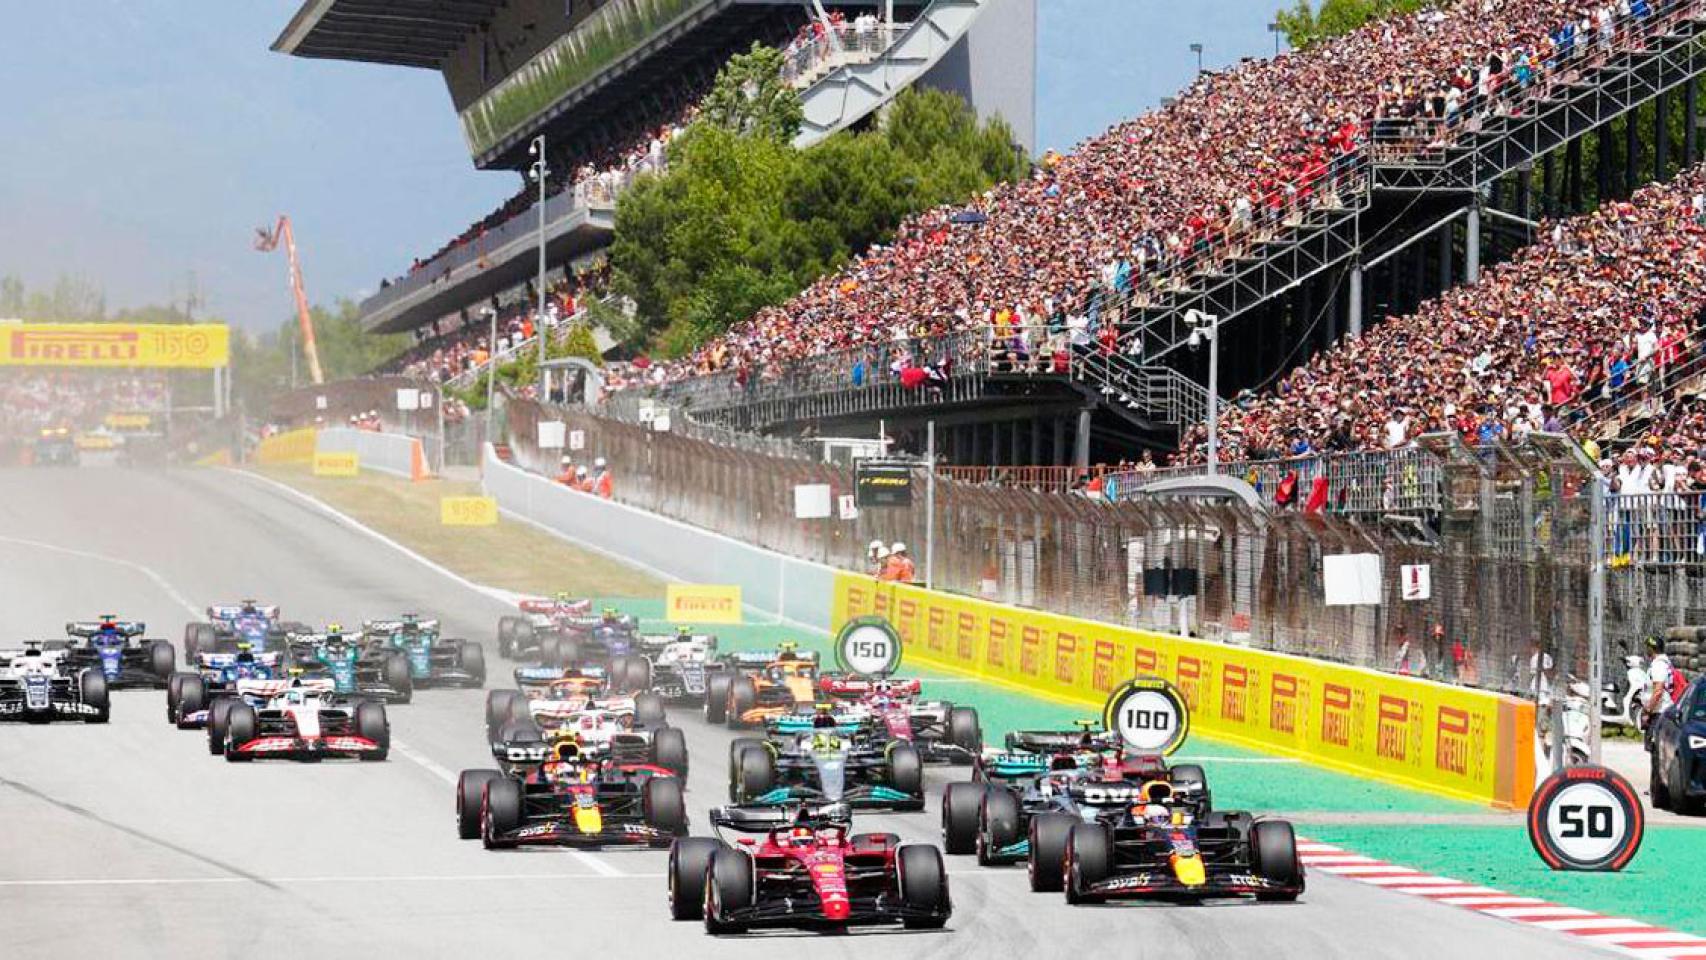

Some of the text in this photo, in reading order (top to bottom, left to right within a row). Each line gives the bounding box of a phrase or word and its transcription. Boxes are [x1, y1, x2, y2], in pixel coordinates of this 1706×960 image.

[11, 331, 139, 358] PIRELLI
[853, 641, 886, 658] 150
[1127, 709, 1169, 731] 100
[1436, 705, 1469, 776] PIRELLI
[1559, 805, 1613, 838] 50
